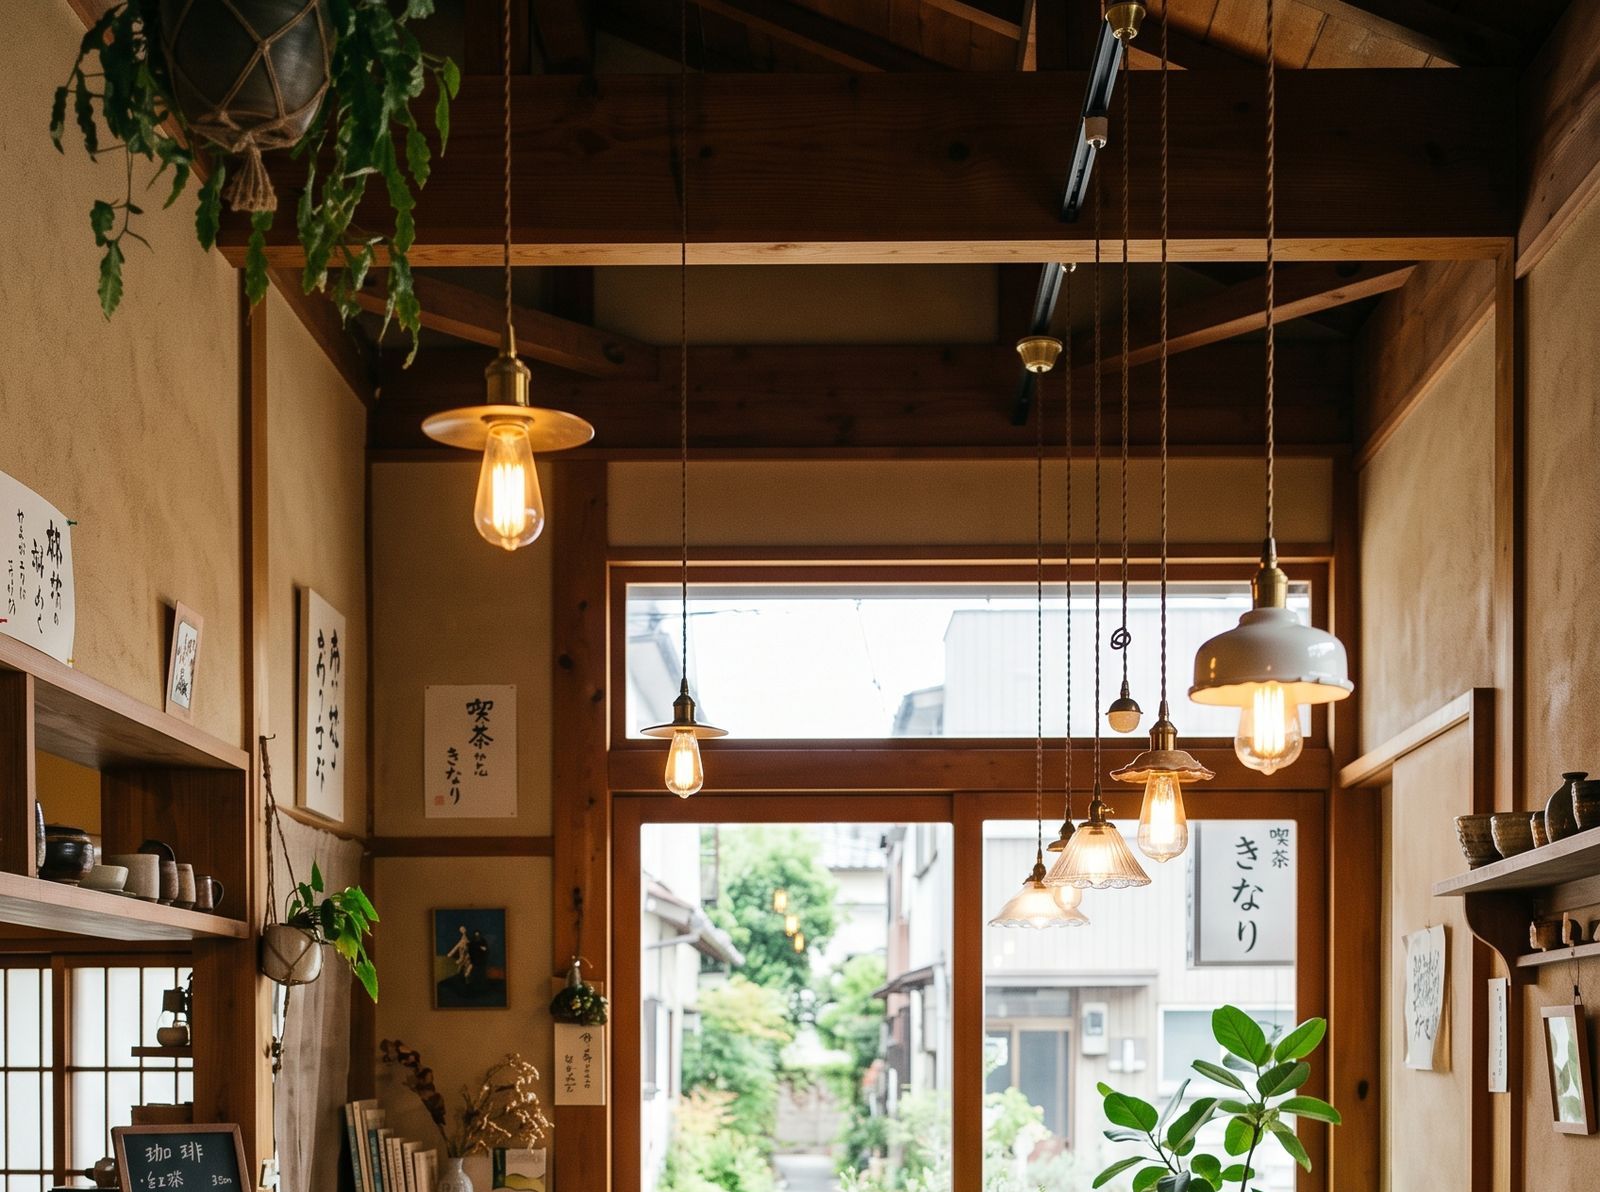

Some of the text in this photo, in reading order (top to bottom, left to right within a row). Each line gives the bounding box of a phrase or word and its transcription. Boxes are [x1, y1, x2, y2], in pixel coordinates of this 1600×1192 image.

[445, 747, 462, 805] きなり
[1269, 827, 1289, 869] 喫茶
[1231, 835, 1264, 953] きなり
